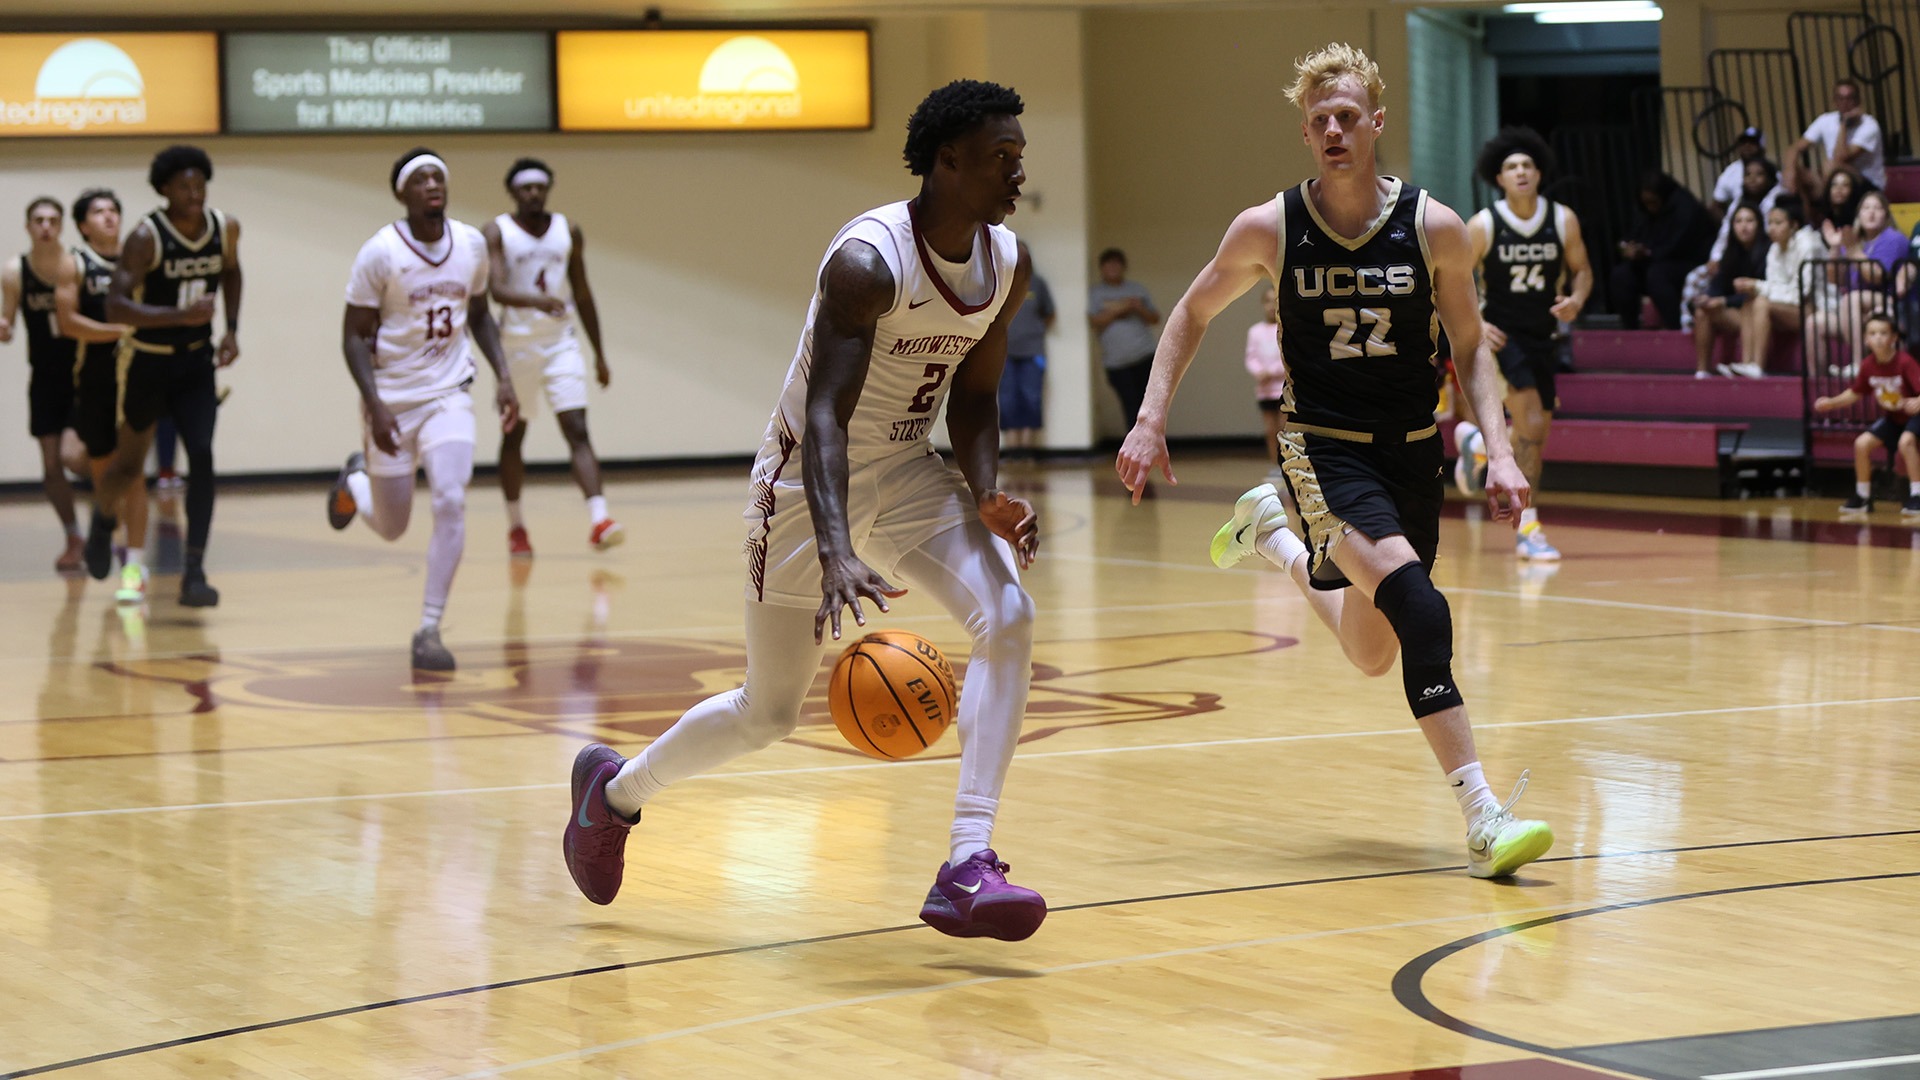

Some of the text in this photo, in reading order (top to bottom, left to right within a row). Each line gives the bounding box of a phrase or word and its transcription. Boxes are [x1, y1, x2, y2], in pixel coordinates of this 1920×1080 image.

[328, 36, 450, 64] The Official
[252, 67, 524, 100] Sports Medicine Provider
[296, 99, 484, 127] for MSU Athletics
[164, 254, 222, 279] UCCS
[1497, 243, 1559, 263] UCCS
[534, 268, 547, 294] 4
[1293, 264, 1416, 298] UCCS
[1509, 264, 1546, 293] 24
[426, 305, 452, 340] 13
[1322, 307, 1398, 360] 22
[907, 362, 949, 413] 2
